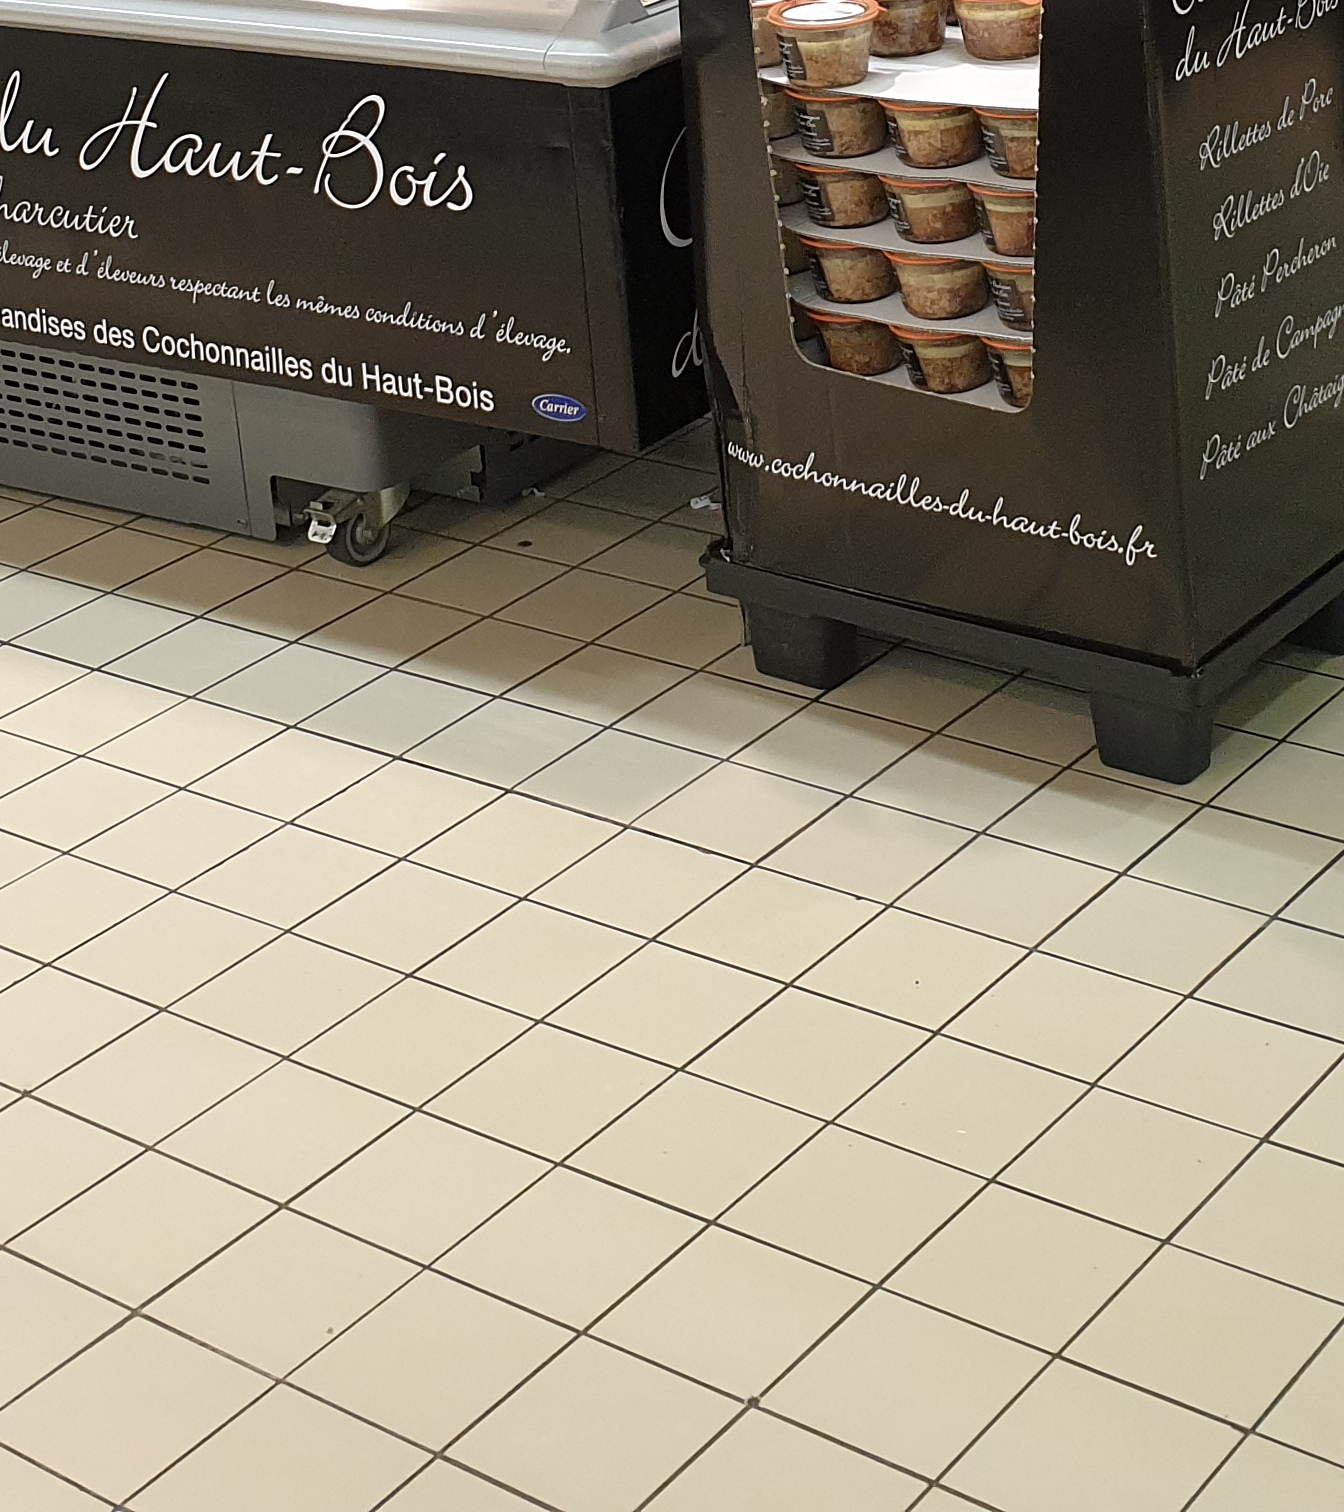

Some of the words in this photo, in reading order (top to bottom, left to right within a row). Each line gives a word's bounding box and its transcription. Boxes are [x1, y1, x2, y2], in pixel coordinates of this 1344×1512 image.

[1175, 25, 1210, 82] du
[78, 71, 474, 212] Haut-Bois
[1199, 120, 1272, 171] Rillettes
[1277, 96, 1295, 132] de
[1300, 78, 1334, 120] Porc
[1213, 188, 1284, 241] Rillettes
[1290, 150, 1330, 199] d'Oie
[169, 275, 261, 304] respectant
[265, 279, 291, 307] les
[296, 295, 361, 320] mêmes
[365, 301, 465, 337] conditions
[1214, 272, 1256, 319] Pâté
[1261, 236, 1337, 293] Percheron
[93, 319, 135, 350] des
[141, 324, 313, 381] Cochonnailles
[321, 357, 354, 388] du
[360, 362, 496, 413] Haut-Bois
[538, 398, 580, 417] Carrier
[1205, 354, 1247, 401] Pâté
[1251, 336, 1271, 372] de
[1199, 433, 1242, 481] Pâté
[1246, 419, 1277, 451] aux
[727, 440, 1158, 566] www.cochonnailles-du-haut-bois.fr
